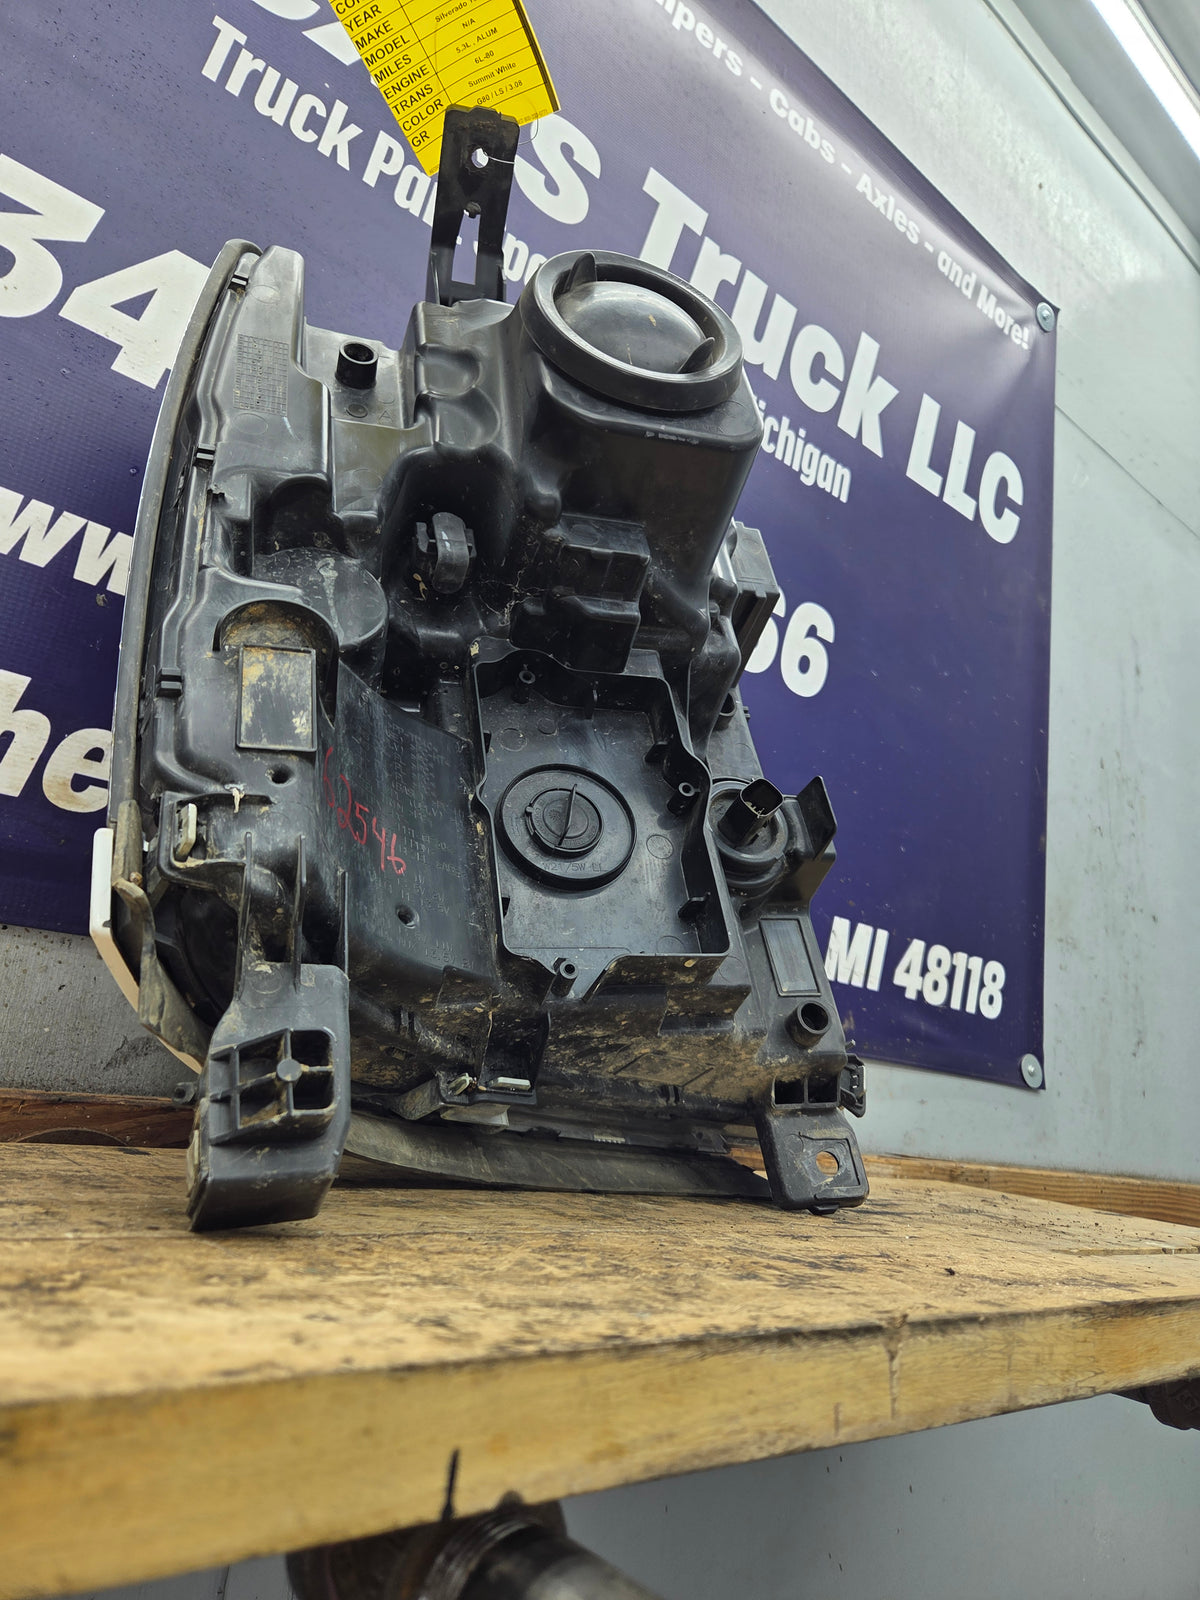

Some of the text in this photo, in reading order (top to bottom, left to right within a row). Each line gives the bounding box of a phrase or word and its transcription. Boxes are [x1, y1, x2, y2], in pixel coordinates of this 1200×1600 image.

[335, 0, 361, 15] CO
[344, 4, 382, 32] YEAR
[354, 20, 393, 50] MAKE
[364, 35, 410, 67] MODEL
[435, 1, 468, 23] Silverado
[374, 18, 476, 83] MILES N/A
[383, 64, 430, 99] ENGINE
[476, 26, 498, 42] ALUM
[392, 50, 495, 115] TRANS 6L-80
[201, 15, 363, 171] Truck
[402, 62, 517, 131] COLOR Summit White
[411, 130, 430, 147] GR
[476, 94, 490, 105] G80
[769, 88, 835, 164] Cabs
[855, 173, 921, 244] Axles
[937, 250, 977, 300] and
[975, 284, 1030, 350] More!
[638, 167, 899, 458] Truck
[905, 392, 1024, 544] LLC
[824, 916, 1006, 1020] MI 48118
